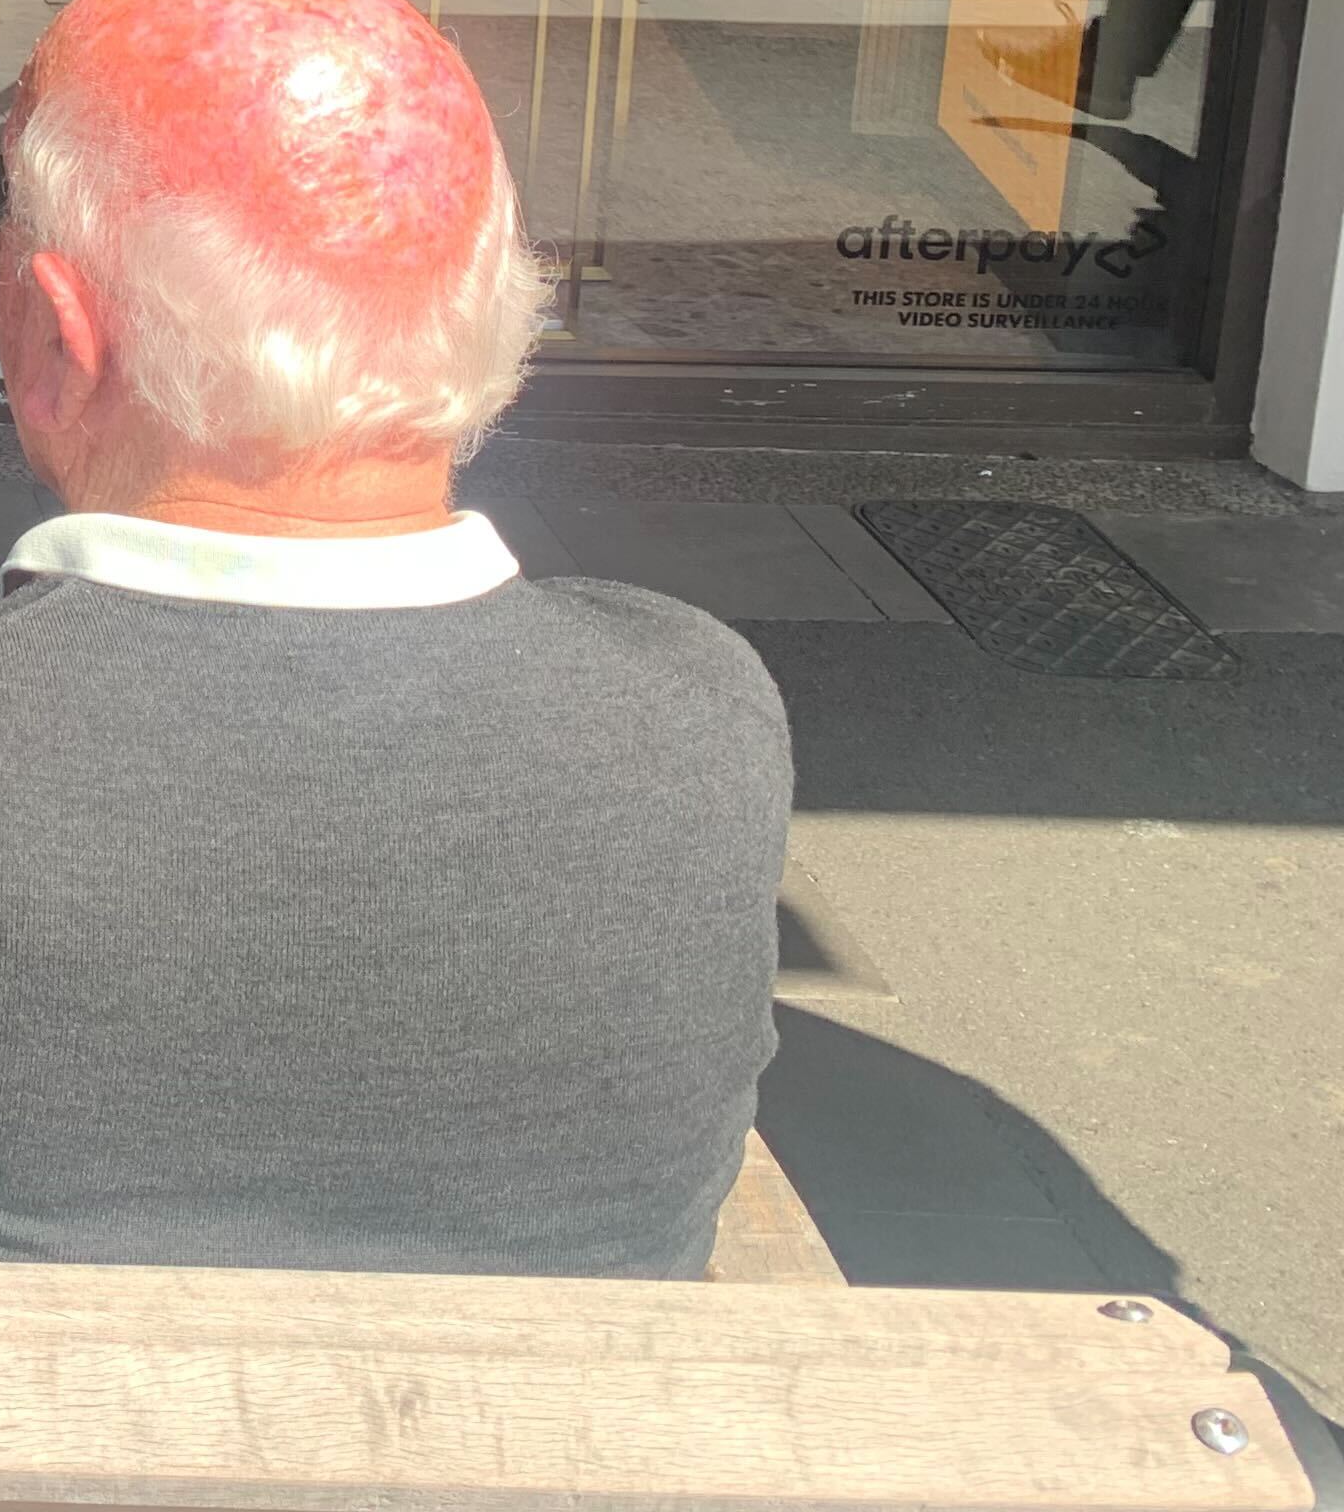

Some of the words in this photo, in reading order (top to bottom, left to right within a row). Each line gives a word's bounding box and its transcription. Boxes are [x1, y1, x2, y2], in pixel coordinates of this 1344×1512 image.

[835, 214, 1098, 277] afterpay
[851, 289, 896, 307] THIS
[901, 290, 966, 308] STORE
[971, 291, 990, 308] IS
[996, 291, 1069, 310] UNDER
[1074, 294, 1102, 311] 24
[897, 311, 962, 328] VIDEO
[966, 312, 1120, 330] SURVEILLANCE
